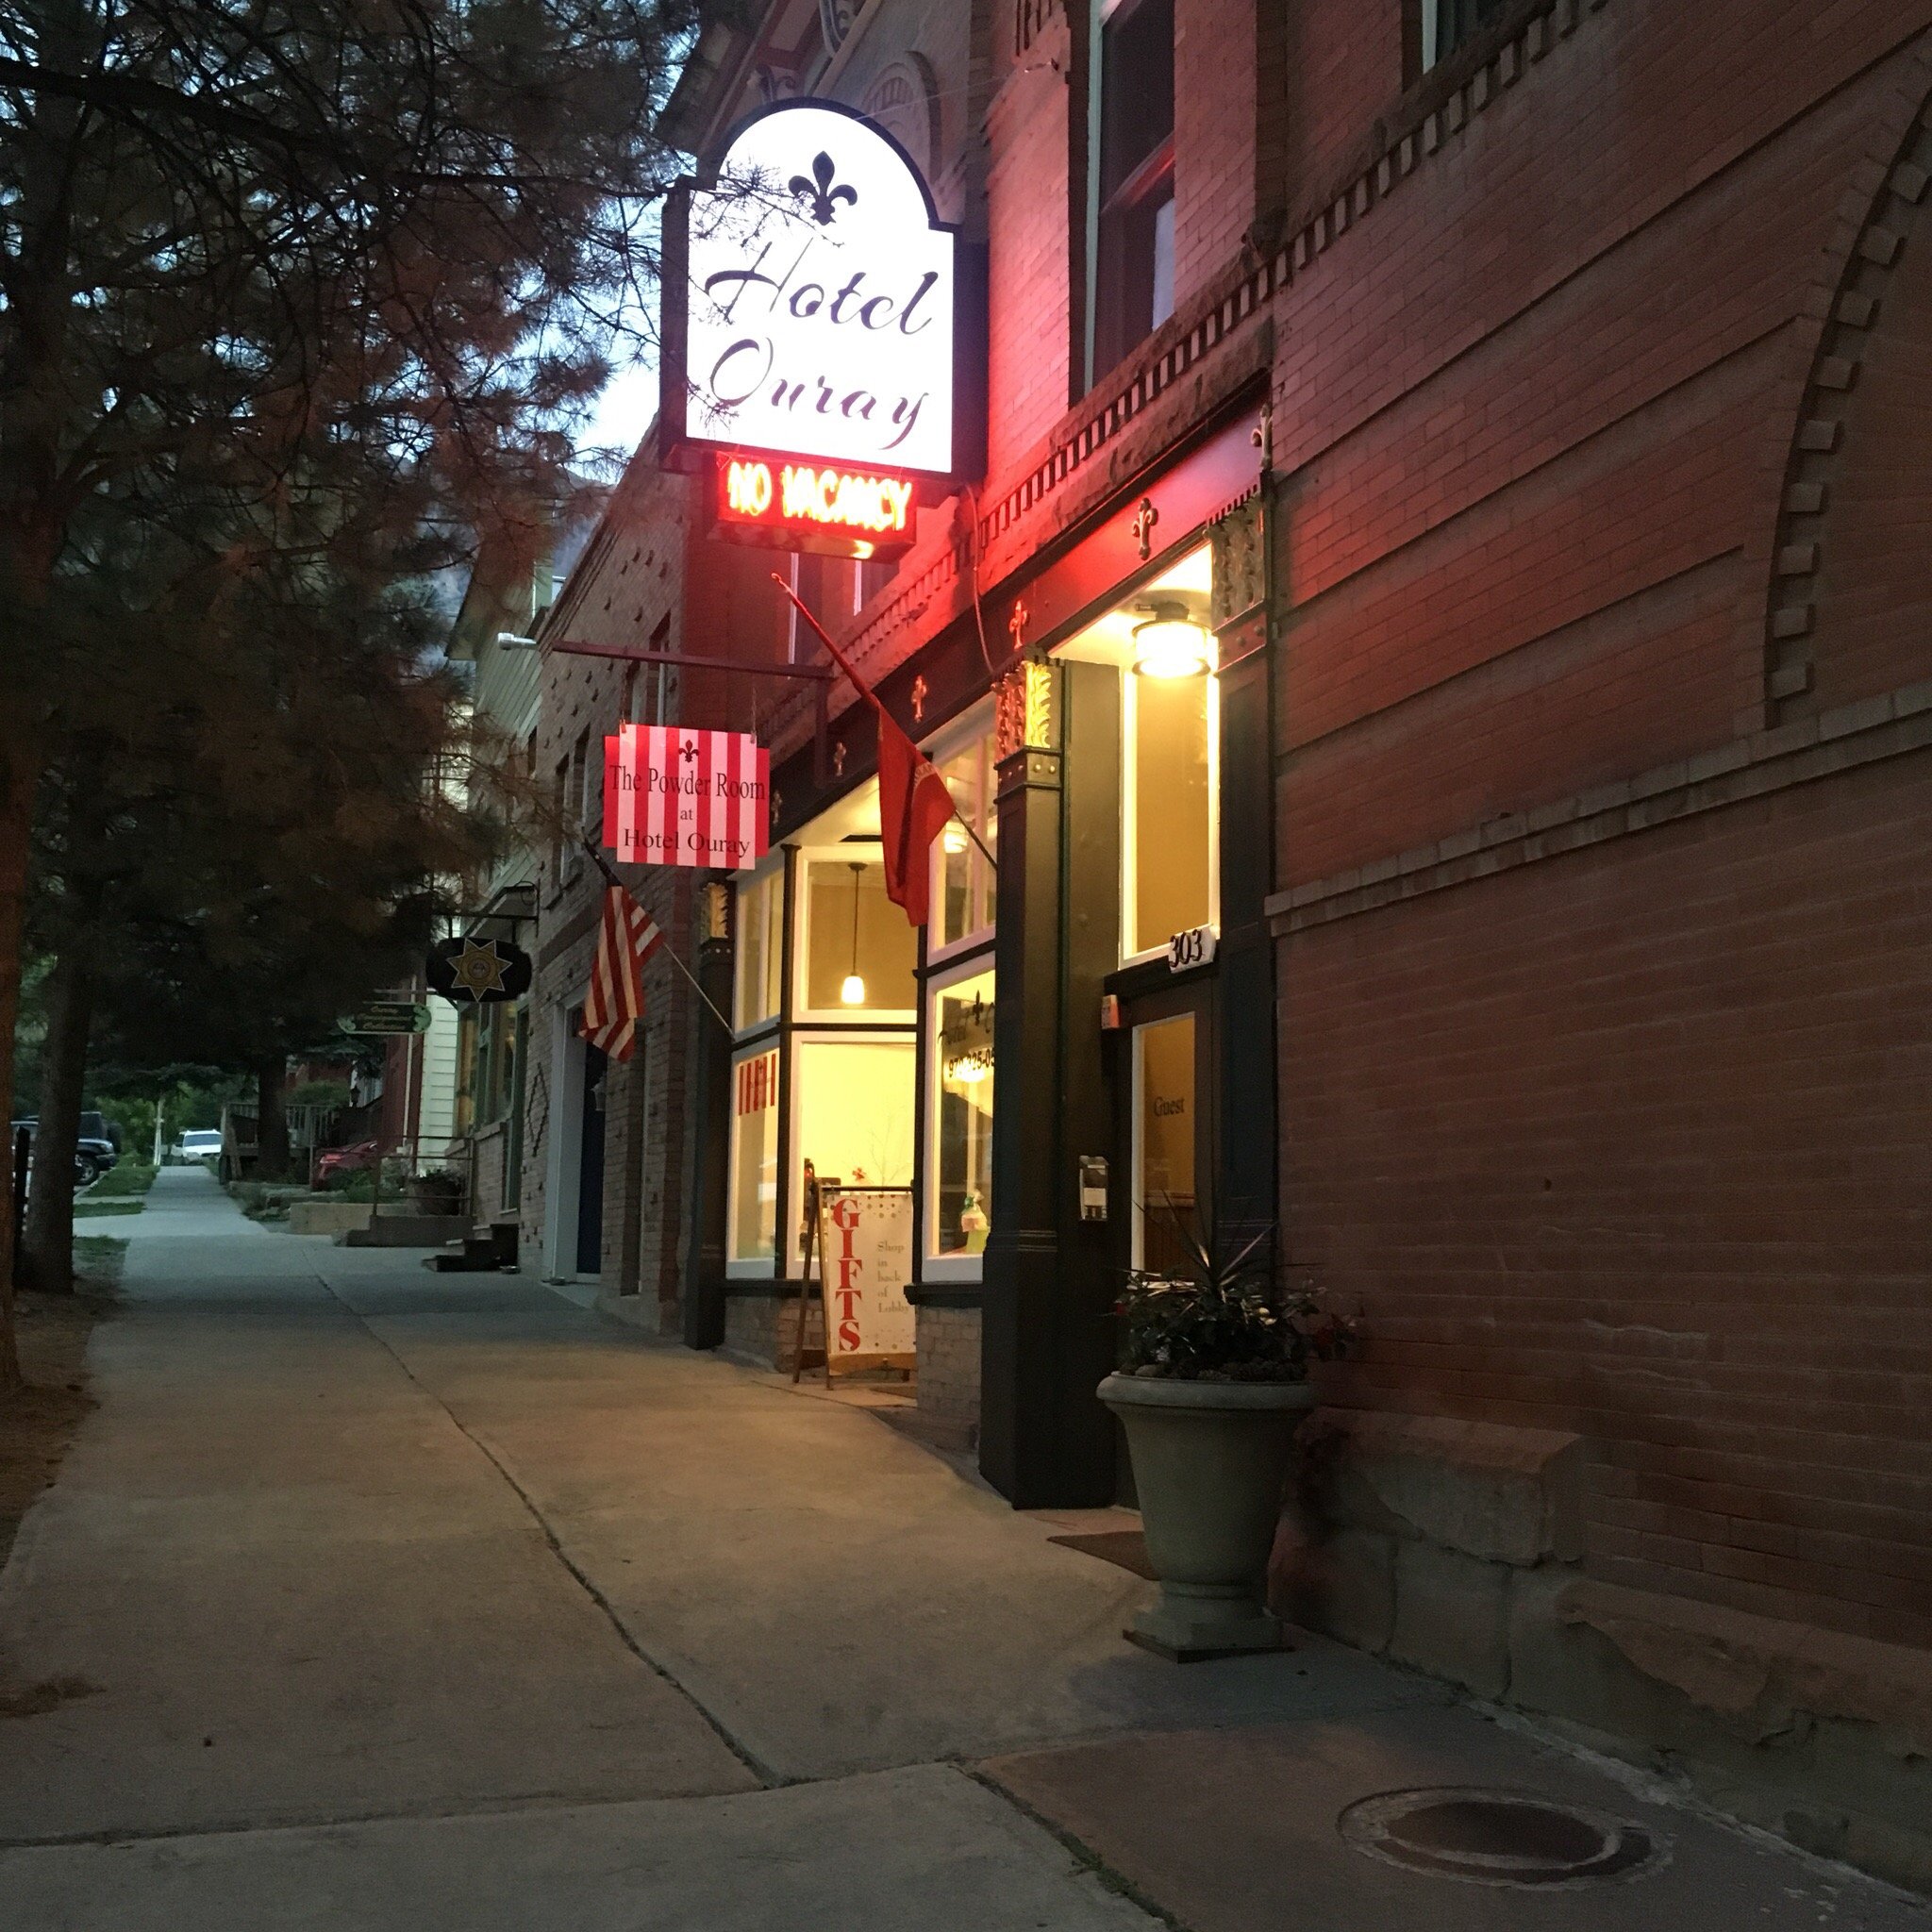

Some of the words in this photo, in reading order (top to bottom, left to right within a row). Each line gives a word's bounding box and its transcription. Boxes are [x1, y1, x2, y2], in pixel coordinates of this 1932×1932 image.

[705, 237, 939, 335] Hotel
[709, 337, 929, 450] Ouray
[727, 461, 773, 516] NO
[780, 465, 912, 532] VACANCY
[609, 765, 642, 792] The
[648, 768, 711, 797] Powder
[716, 772, 766, 800] Room
[680, 808, 693, 821] at
[624, 828, 679, 850] Hotel
[687, 832, 751, 858] Ouray
[1169, 929, 1203, 968] 303
[1154, 1096, 1185, 1117] Guest
[877, 1240, 905, 1254] Shop
[877, 1257, 889, 1267] in
[833, 1198, 863, 1352] GIFTS
[877, 1285, 889, 1297] of
